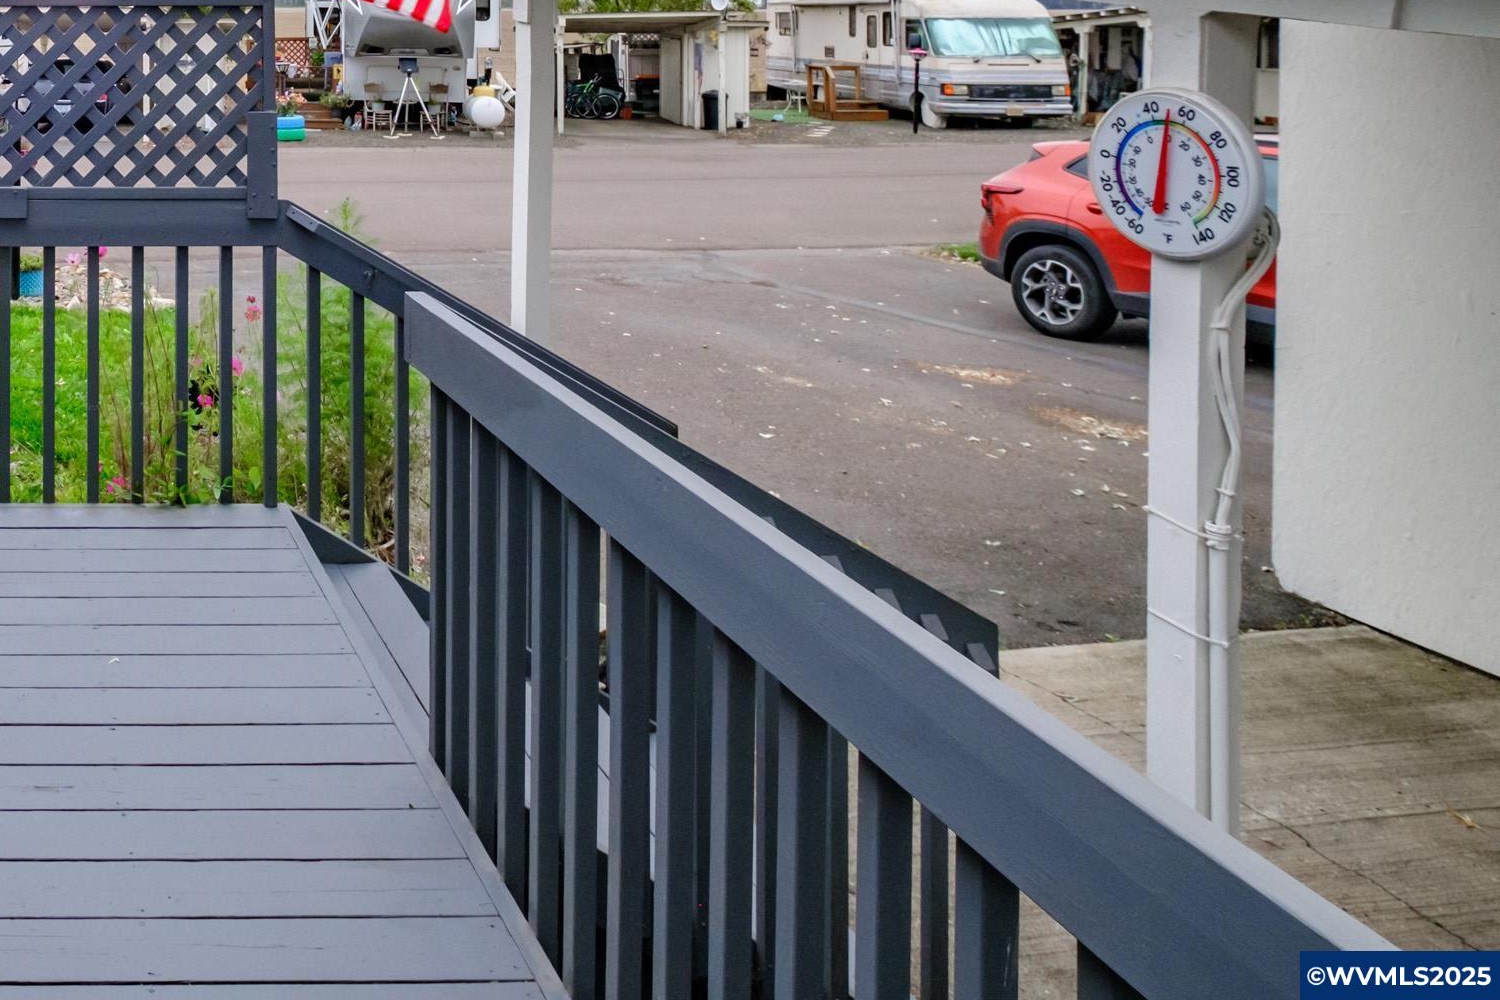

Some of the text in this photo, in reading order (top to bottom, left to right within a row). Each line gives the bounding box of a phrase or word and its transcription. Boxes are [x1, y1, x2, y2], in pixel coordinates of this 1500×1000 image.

[1143, 101, 1159, 114] 40
[1178, 106, 1195, 121] 60
[1111, 117, 1126, 133] 20
[1178, 140, 1190, 151] 20
[1210, 131, 1227, 149] 80
[1100, 149, 1110, 158] 0
[1100, 170, 1113, 192] -20
[1197, 173, 1206, 185] 40
[1226, 166, 1240, 188] 100
[1109, 194, 1126, 215] -40
[1218, 202, 1236, 223] 120
[1125, 217, 1144, 234] -60
[1192, 228, 1215, 245] 140
